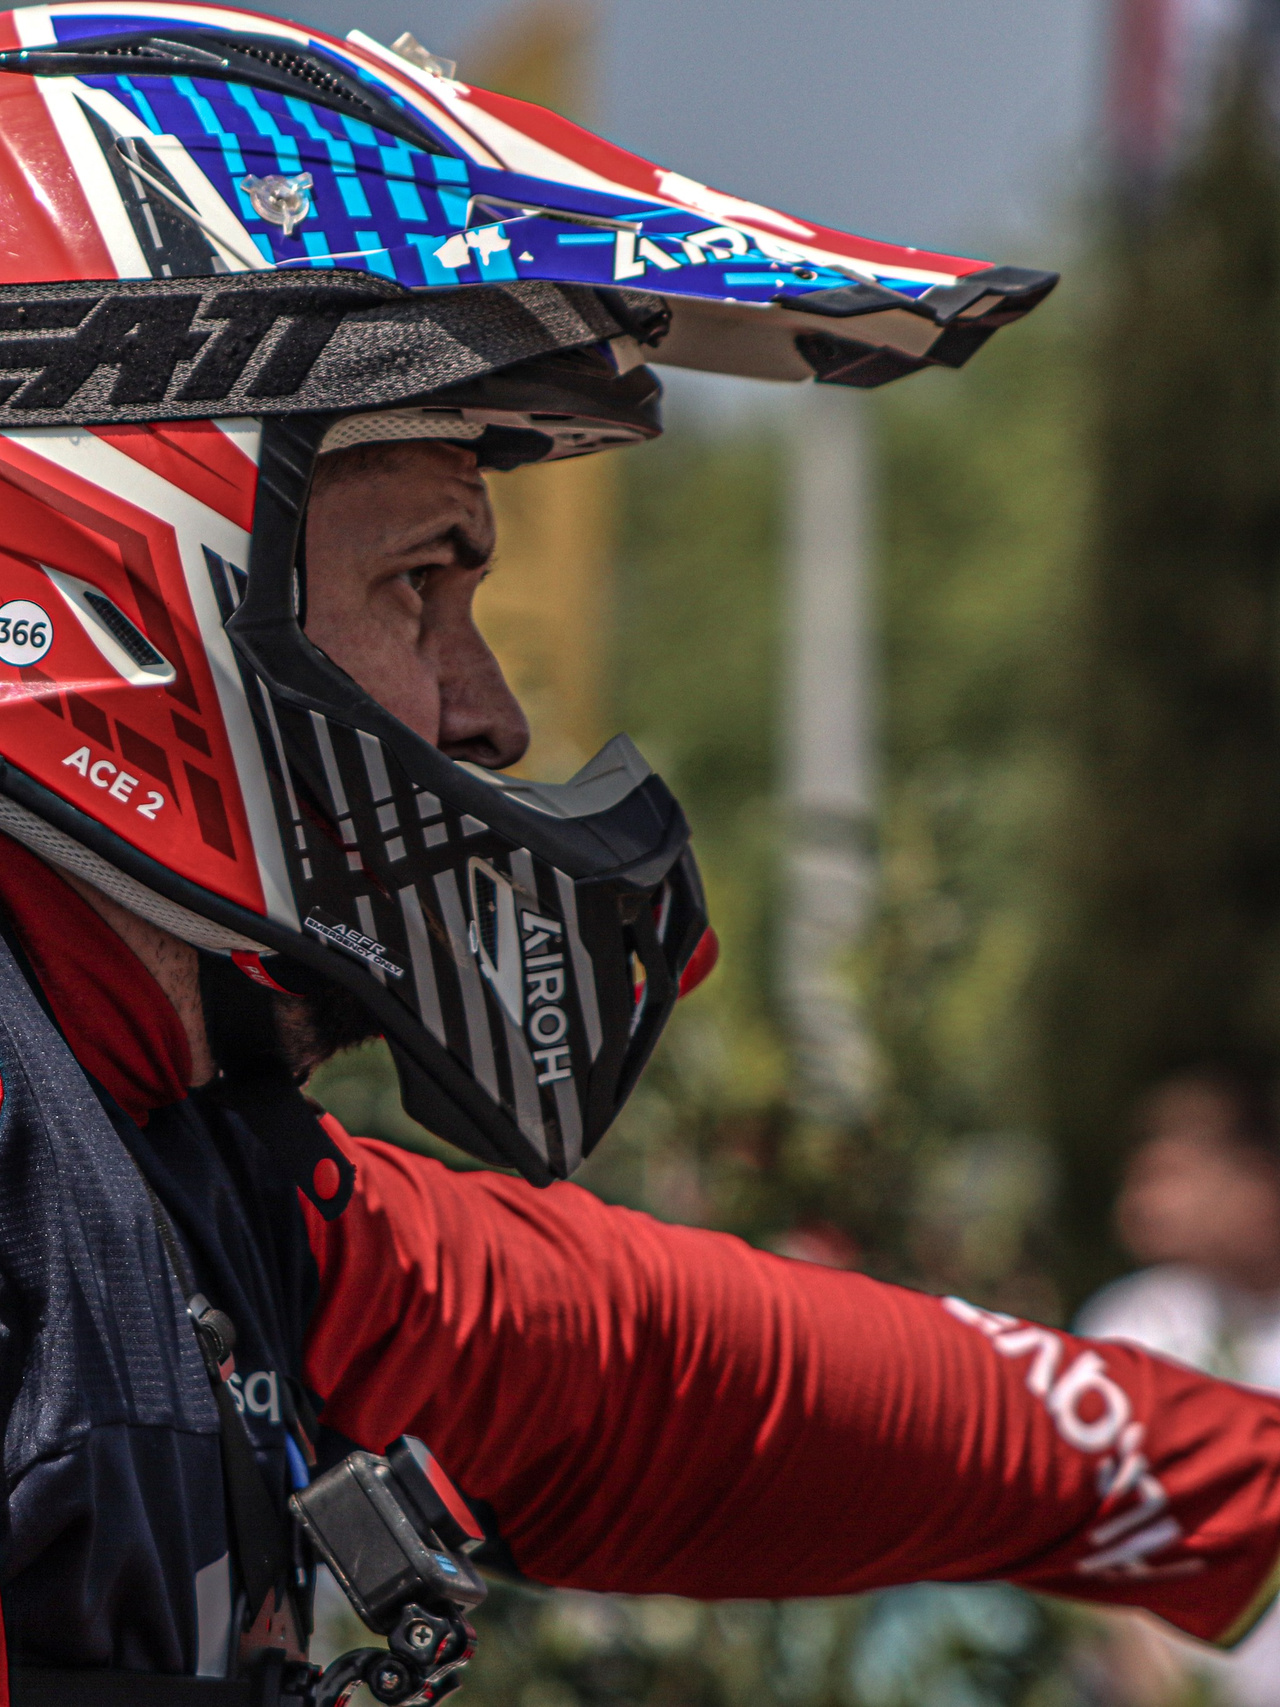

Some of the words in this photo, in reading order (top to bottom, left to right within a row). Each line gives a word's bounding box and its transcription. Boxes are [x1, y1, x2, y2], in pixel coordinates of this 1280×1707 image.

[60, 744, 140, 804] ACE
[135, 789, 166, 821] 2
[306, 917, 373, 958] EMERGENCY
[372, 955, 402, 975] ONLY
[331, 922, 387, 955] AEFR
[522, 909, 573, 1086] AIROH
